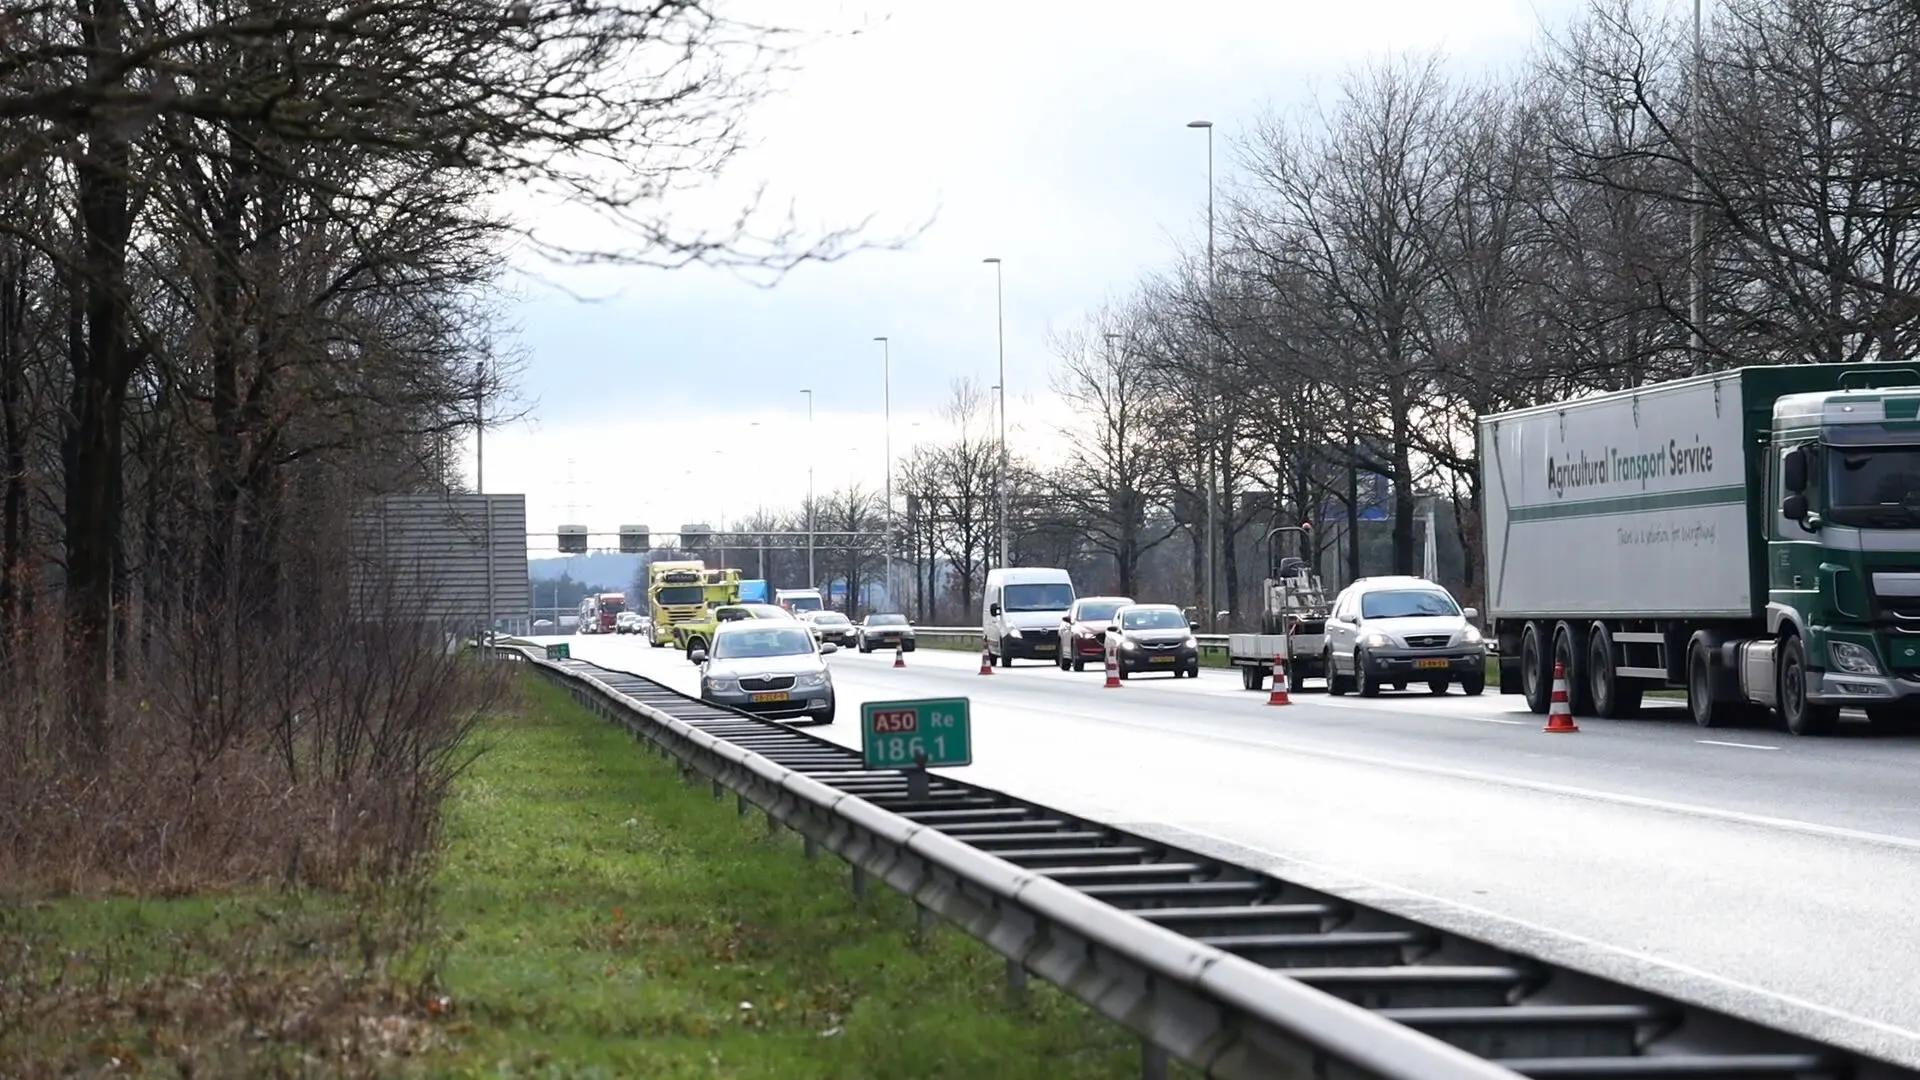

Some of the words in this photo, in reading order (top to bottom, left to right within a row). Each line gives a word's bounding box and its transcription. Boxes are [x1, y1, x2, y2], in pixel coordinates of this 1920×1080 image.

[1548, 446, 1609, 498] Agricultural
[1611, 445, 1666, 490] Transport
[1669, 434, 1713, 476] Service
[876, 713, 914, 731] A50
[931, 712, 955, 728] Re
